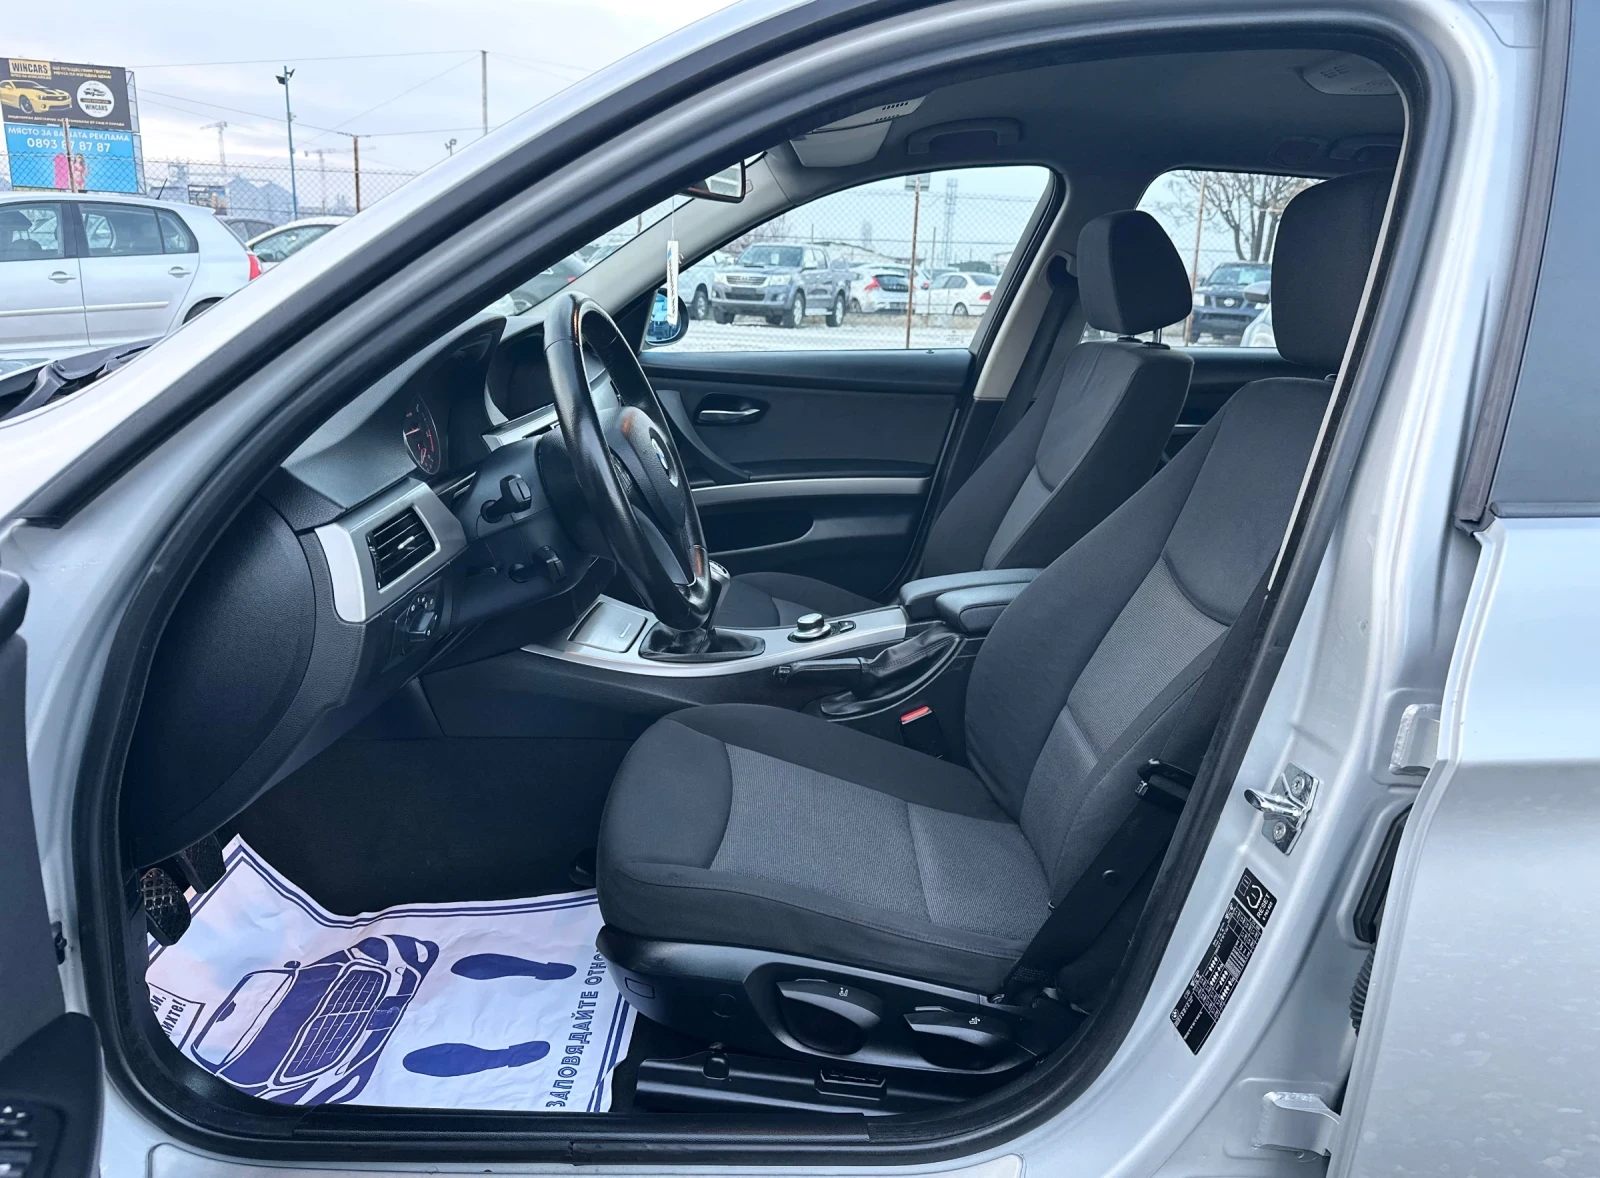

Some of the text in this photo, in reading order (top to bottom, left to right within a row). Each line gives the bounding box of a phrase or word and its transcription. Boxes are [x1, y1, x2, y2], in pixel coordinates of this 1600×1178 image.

[11, 62, 48, 74] WINCARS
[8, 127, 40, 136] МЯСТО
[90, 132, 130, 142] РЕКЛАМА
[26, 137, 58, 149] 0893
[79, 141, 93, 151] 87
[96, 142, 111, 152] 87
[1256, 892, 1270, 919] RESET
[545, 949, 607, 1107] ЗАПОВЯДАЙТЕ ОТНО
